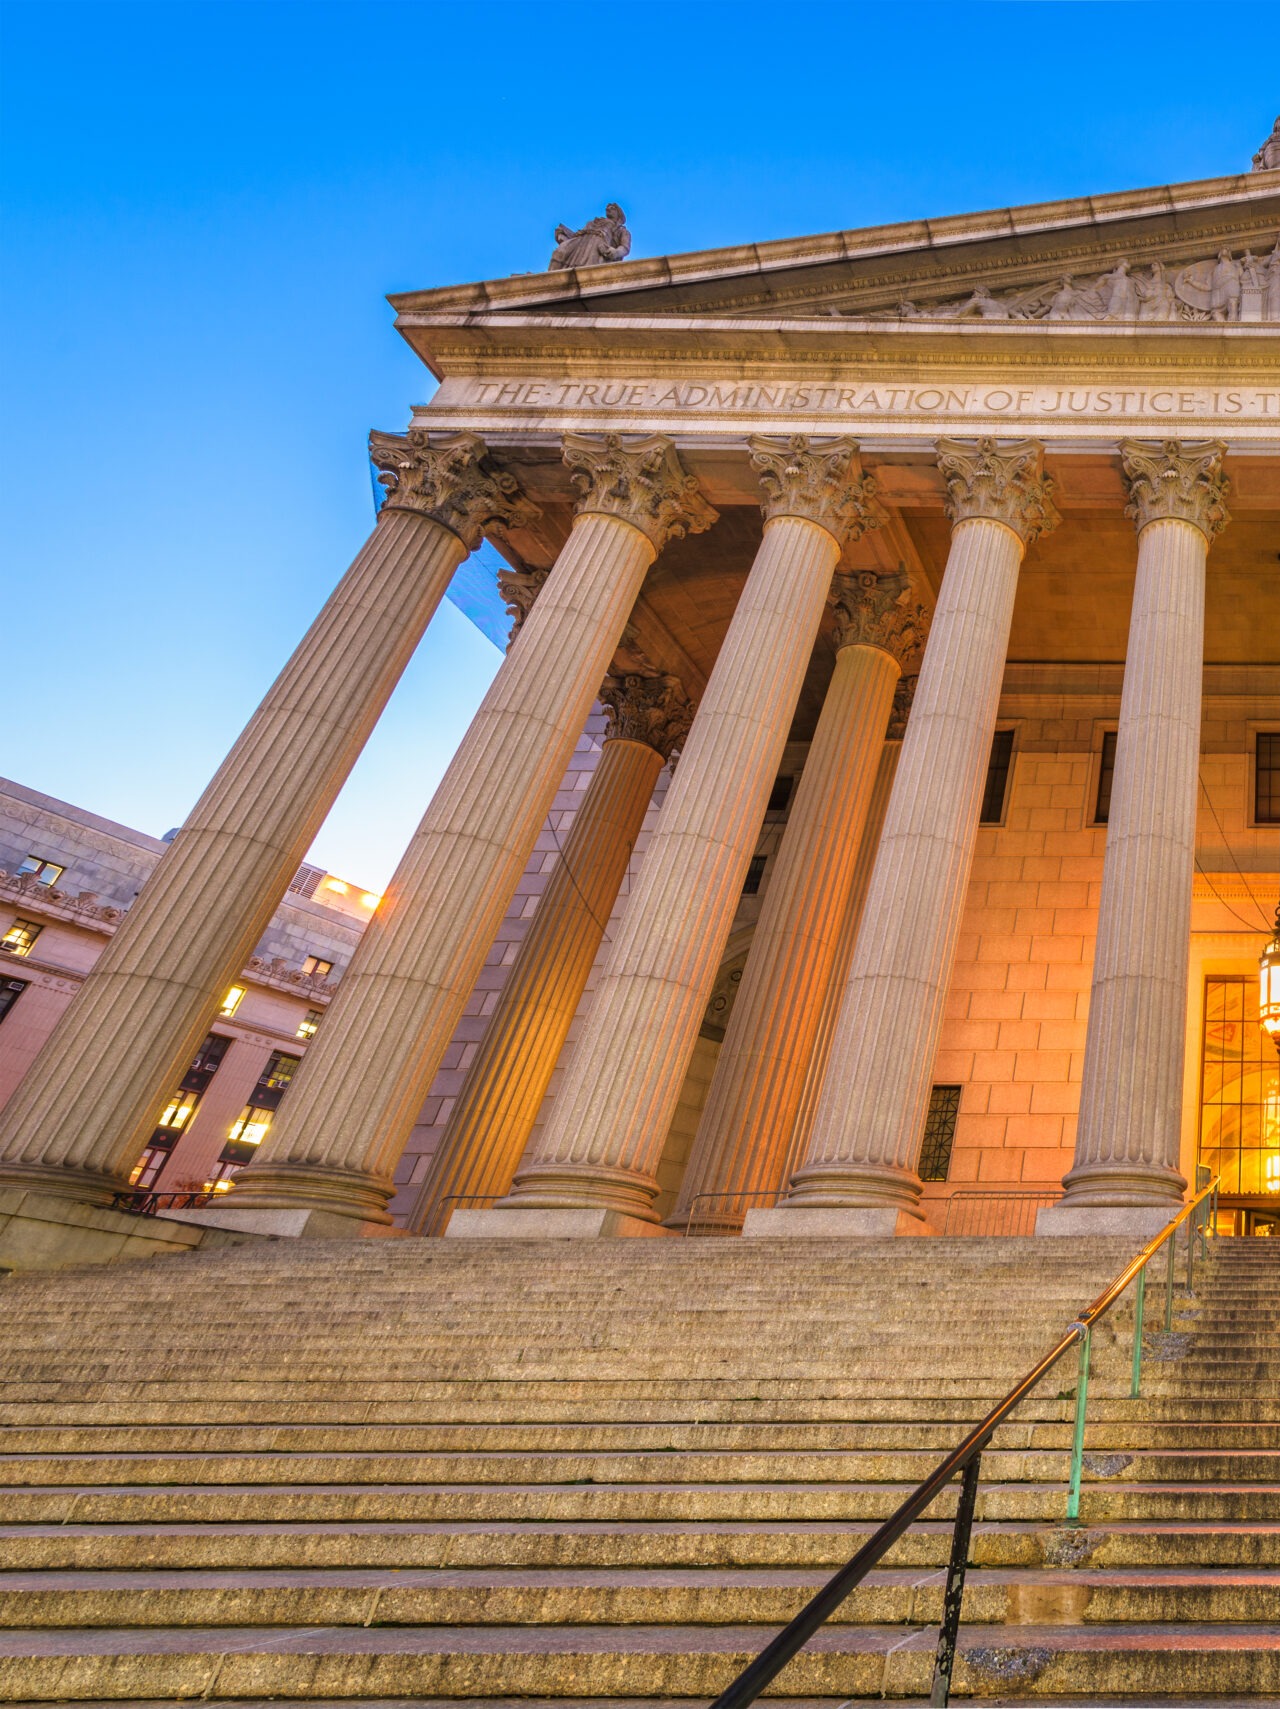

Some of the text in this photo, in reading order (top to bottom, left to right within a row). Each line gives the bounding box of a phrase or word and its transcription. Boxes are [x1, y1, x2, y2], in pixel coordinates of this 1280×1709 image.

[476, 382, 547, 405] THE
[559, 383, 649, 407] TRUE
[659, 385, 971, 411] ADMINISTRATION
[983, 390, 1034, 412] OF
[1040, 390, 1196, 414] JUSTICE
[1213, 392, 1243, 414] IS
